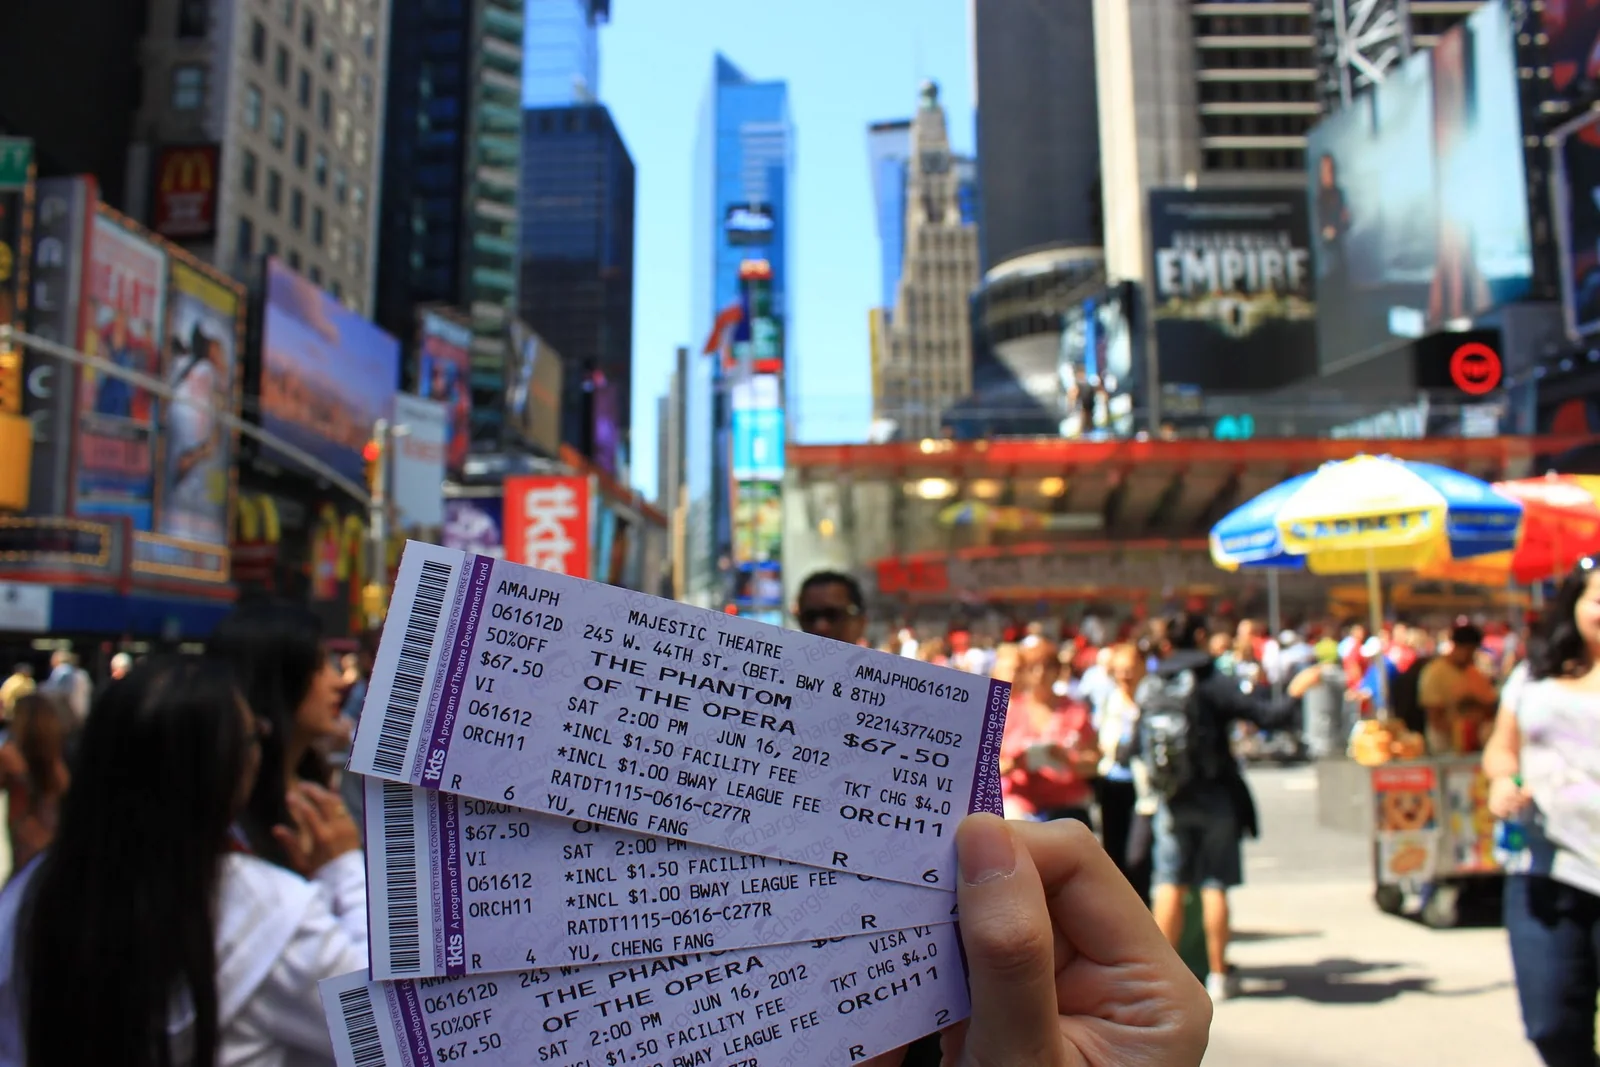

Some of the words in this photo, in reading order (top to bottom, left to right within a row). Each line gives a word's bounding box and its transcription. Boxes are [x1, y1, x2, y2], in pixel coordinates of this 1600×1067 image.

[1155, 247, 1308, 297] EMPIRE
[476, 562, 489, 586] Fund
[455, 576, 467, 605] REVERSE
[497, 580, 560, 607] AMAJPH
[452, 606, 460, 618] ON
[460, 585, 484, 648] Development
[491, 603, 563, 632] 061612D
[442, 619, 458, 661] CONDITIONS
[485, 626, 549, 653] 50%OFF
[628, 610, 707, 641] MAJESTIC
[717, 631, 783, 660] THEATRE
[452, 648, 468, 683] Theatre
[480, 651, 544, 679] $67.50
[583, 624, 614, 643] 245
[623, 633, 640, 651] W.
[653, 640, 694, 663] 44TH
[702, 652, 728, 672] ST.
[742, 661, 785, 685] (BET.
[796, 674, 825, 693] BWY
[832, 682, 842, 698] &
[850, 687, 886, 707] 8TH)
[591, 650, 647, 677] THE
[658, 666, 792, 710] PHANTOM
[434, 669, 446, 692] TERMS
[450, 683, 459, 694] of
[475, 675, 495, 693] VI
[431, 692, 439, 703] TO
[583, 675, 622, 694] OF
[635, 685, 691, 712] THE
[702, 702, 796, 736] OPERA
[424, 703, 436, 733] SUBJECT
[441, 696, 456, 736] program
[468, 699, 532, 727] 061612
[994, 687, 1011, 747] 800-447-7400
[437, 737, 446, 745] A
[462, 724, 525, 751] ORCH11
[567, 696, 599, 716] SAT
[617, 707, 659, 729] 2:00
[667, 719, 689, 736] PM
[716, 730, 746, 749] JUN
[756, 737, 781, 759] 16,
[792, 745, 830, 767] 2012
[856, 712, 963, 748] 922143774052
[623, 733, 674, 758] $1.50
[682, 746, 761, 776] FACILITY
[768, 765, 798, 784] FEE
[842, 732, 950, 768] $67.50
[973, 685, 1002, 812] www.telecharge.com
[414, 755, 424, 777] ADMIT
[424, 749, 446, 780] tkts
[429, 790, 437, 800] ON
[451, 774, 462, 790] R
[503, 785, 515, 800] 6
[617, 757, 669, 782] $1.00
[676, 770, 718, 792] BWAY
[726, 781, 785, 806] LEAGUE
[792, 794, 822, 814] FEE
[893, 767, 928, 788] VISA
[937, 776, 954, 793] VI
[550, 769, 751, 824] RATDT1115-0616-C277R
[844, 780, 872, 799] TKT
[879, 789, 907, 807] CHG
[915, 795, 951, 815] $4.0
[429, 802, 439, 848] CONDITIONS
[547, 793, 575, 816] YU,
[587, 803, 639, 826] CHENG
[647, 814, 689, 836] FANG
[839, 805, 943, 838] ORCH11
[465, 822, 530, 842] $67.50
[447, 830, 457, 866] Theatre
[466, 851, 487, 867] VI
[563, 843, 594, 860] SAT
[615, 838, 657, 856] 2:00
[666, 839, 687, 851] PM
[431, 856, 440, 880] TERMS
[447, 866, 457, 877] of
[626, 861, 679, 880] $1.50
[688, 855, 767, 875] FACILITY
[832, 851, 849, 868] R
[922, 868, 939, 884] 6
[433, 880, 440, 892] TO
[467, 873, 533, 893] 061612
[628, 886, 680, 905] $1.00
[690, 881, 730, 901] BWAY
[741, 874, 799, 895] LEAGUE
[809, 871, 838, 887] FEE
[433, 892, 442, 923] SUBJECT
[450, 878, 461, 920] program
[468, 898, 533, 918] ORCH11
[450, 921, 459, 929] A
[567, 902, 772, 936] RATDT1115-0616-C277R
[860, 914, 878, 930] R
[447, 933, 463, 967] tkts
[568, 944, 599, 962] YU,
[611, 937, 663, 957] CHENG
[673, 932, 714, 951] FANG
[868, 931, 907, 954] VISA
[913, 925, 932, 938] VI
[435, 943, 444, 968] ADMIT
[472, 953, 482, 969] R
[526, 949, 536, 964] 4
[830, 971, 857, 993] TKT
[867, 959, 895, 980] CHG
[901, 942, 938, 967] $4.0
[518, 967, 551, 988] 245
[837, 965, 938, 1015] ORCH11
[387, 989, 400, 1019] REVERSE
[424, 981, 498, 1014] 061612D
[535, 979, 597, 1008] THE
[542, 1009, 580, 1033] OF
[593, 988, 654, 1017] THE
[665, 955, 764, 996] OPERA
[394, 1020, 403, 1032] ON
[405, 991, 427, 1055] Development
[430, 1008, 492, 1039] 50%OFF
[538, 1039, 568, 1062] SAT
[589, 1020, 632, 1047] 2:00
[640, 1011, 663, 1031] PM
[692, 993, 722, 1015] JUN
[730, 983, 760, 1001] 16,
[768, 964, 808, 990] 2012
[934, 1008, 951, 1026] 2
[606, 1038, 659, 1067] $1.50
[666, 1010, 745, 1049] FACILITY
[755, 997, 786, 1020] FEE
[723, 1023, 783, 1056] LEAGUE
[790, 1010, 820, 1033] FEE
[436, 1032, 502, 1063] $67.50
[848, 1044, 867, 1062] R
